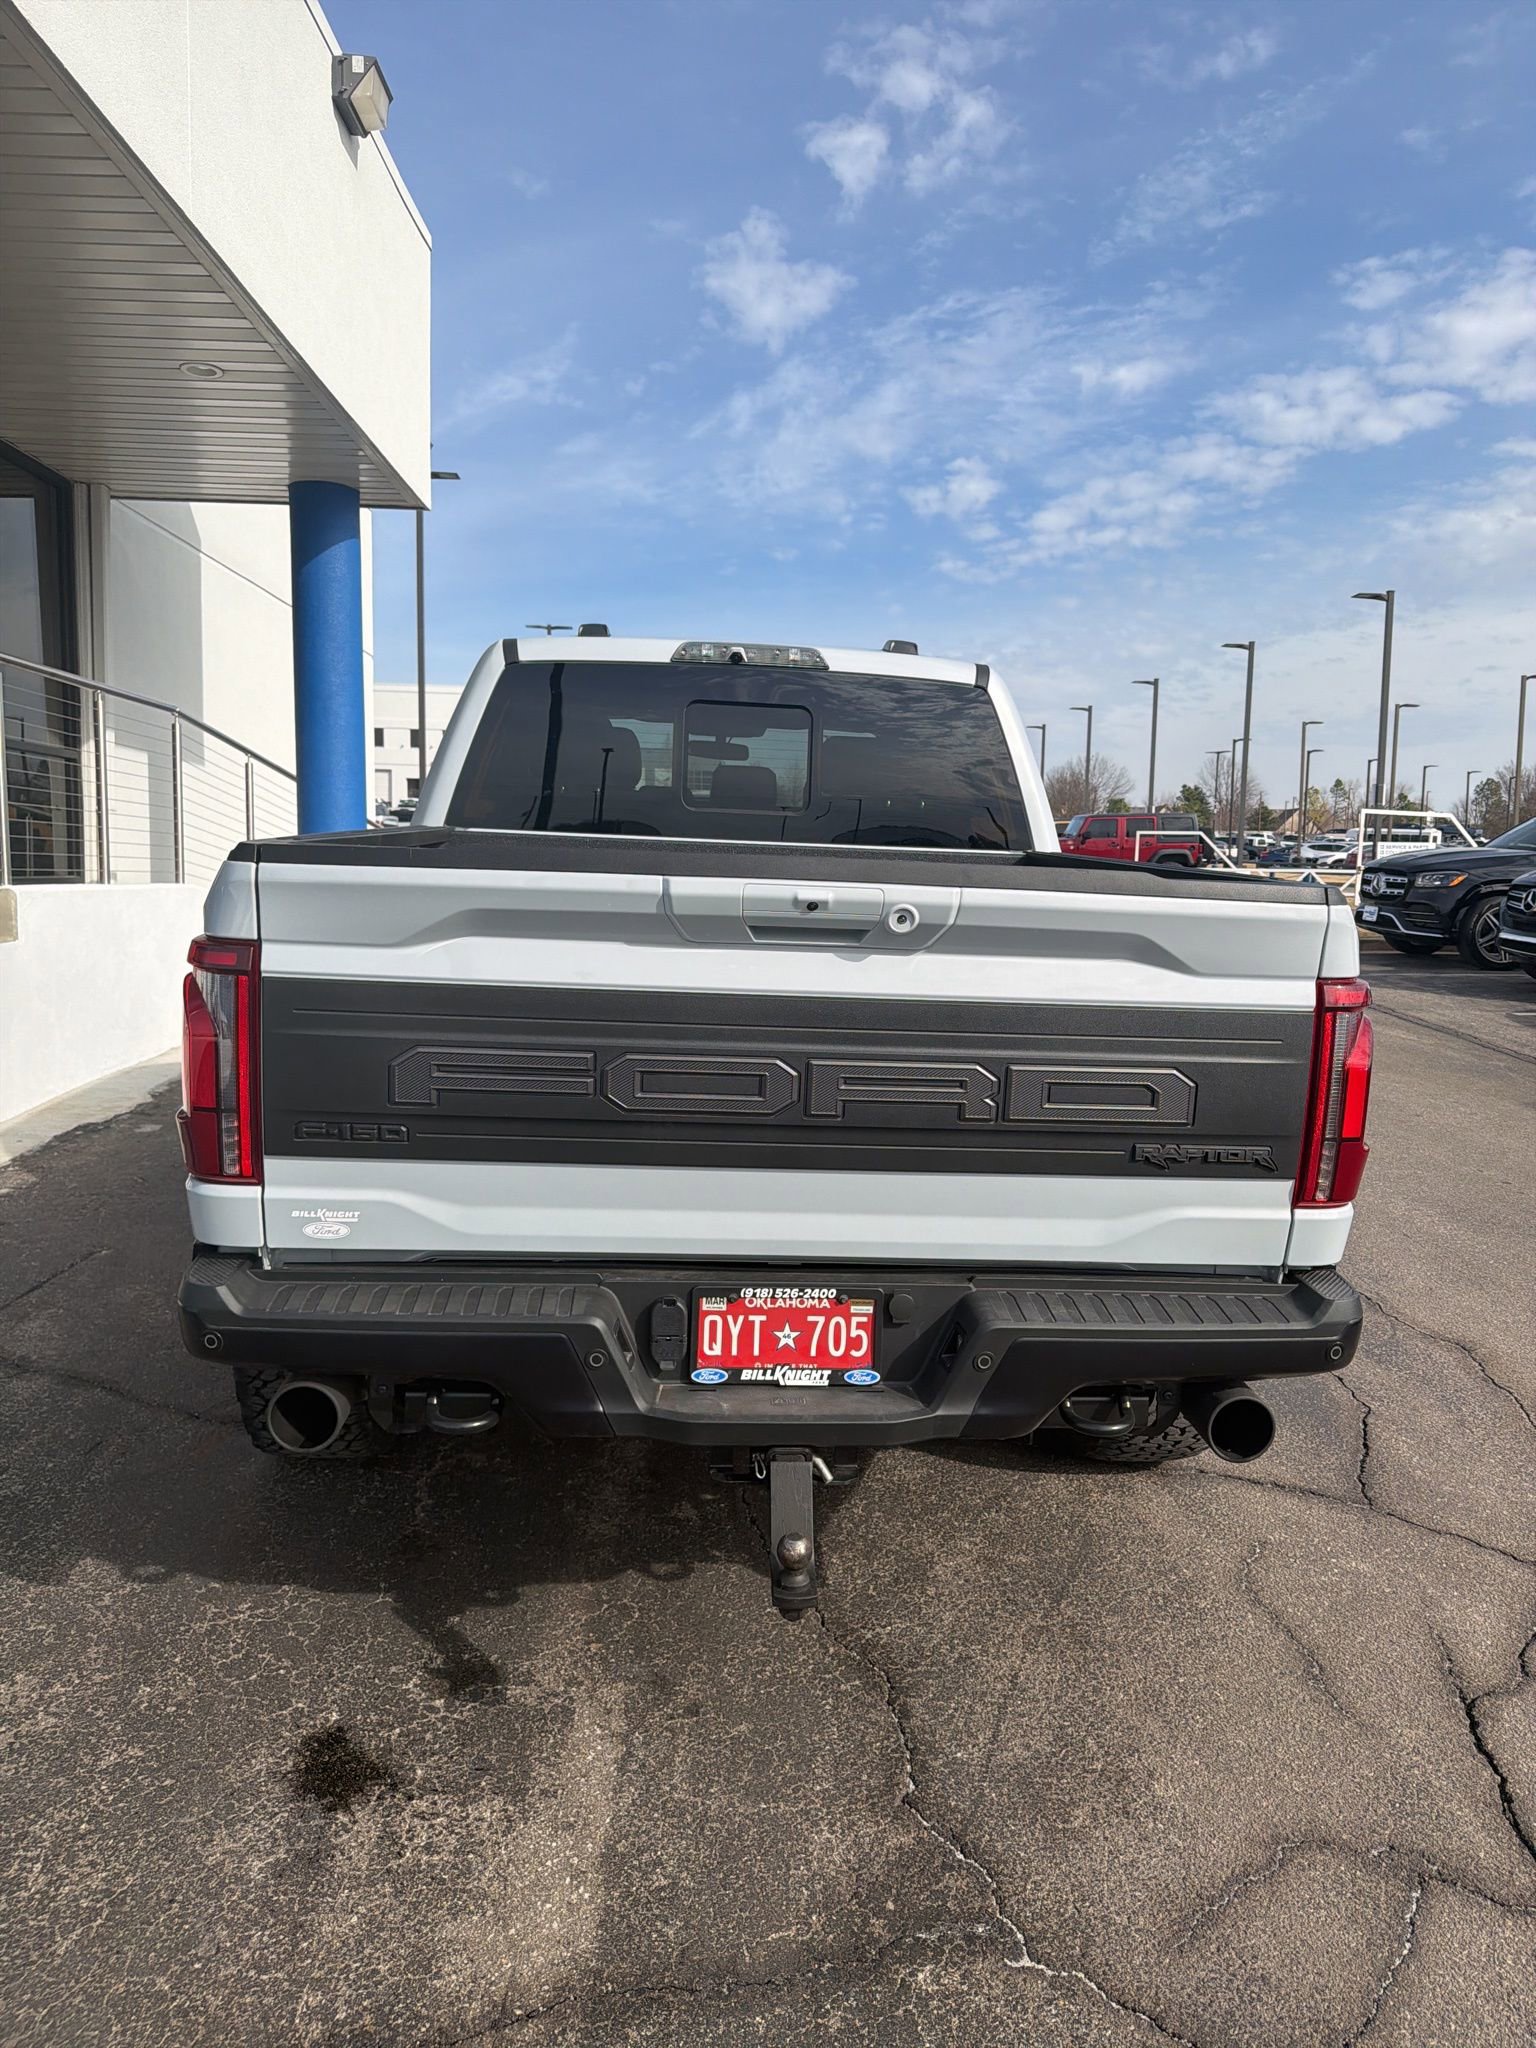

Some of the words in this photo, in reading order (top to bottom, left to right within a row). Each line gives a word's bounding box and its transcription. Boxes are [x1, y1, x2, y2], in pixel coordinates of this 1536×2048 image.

[388, 1045, 1199, 1128] FORD
[1131, 1142, 1278, 1173] RAPTOR
[704, 1296, 725, 1306] MAR
[740, 1288, 773, 1298] (918)
[774, 1288, 837, 1299] 526-2400
[744, 1298, 831, 1310] OKLAHOMA
[703, 1315, 767, 1357] QYT
[806, 1315, 869, 1357] 705
